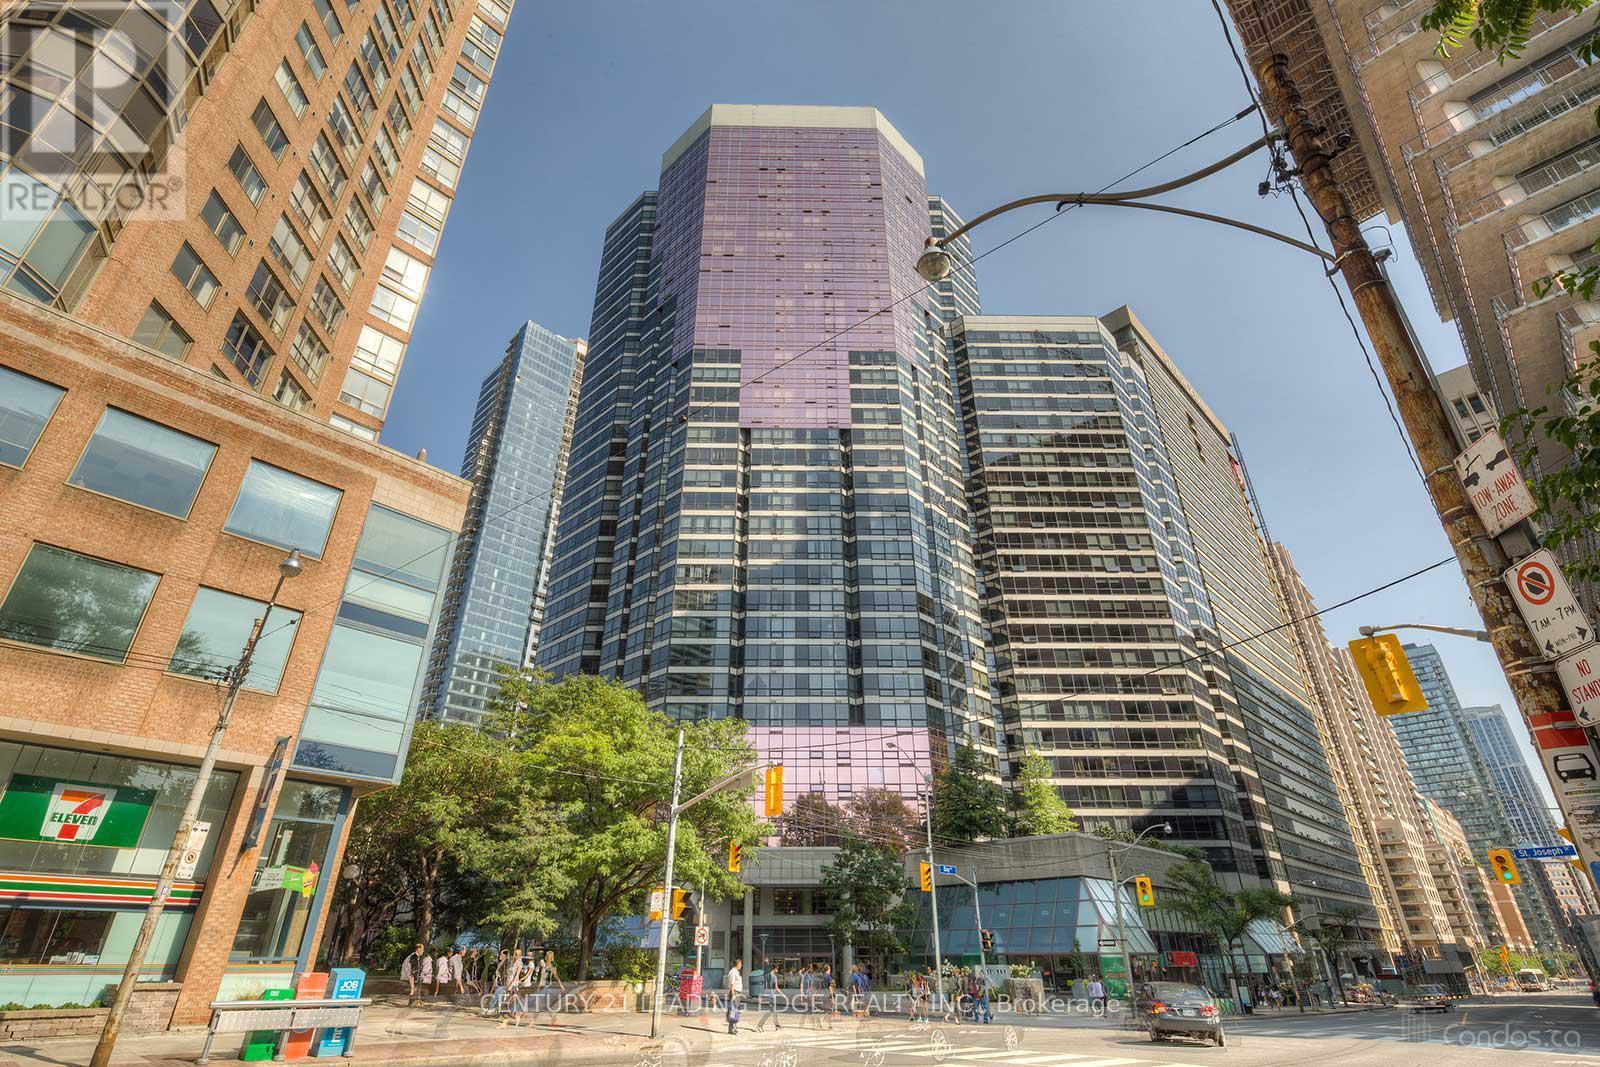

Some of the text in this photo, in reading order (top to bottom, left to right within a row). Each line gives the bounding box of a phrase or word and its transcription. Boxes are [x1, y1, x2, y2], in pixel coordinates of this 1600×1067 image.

[1492, 494, 1519, 522] ZONE
[1575, 658, 1592, 678] NO
[56, 789, 107, 840] 7
[1533, 847, 1564, 857] Joseph
[340, 980, 360, 990] JOB
